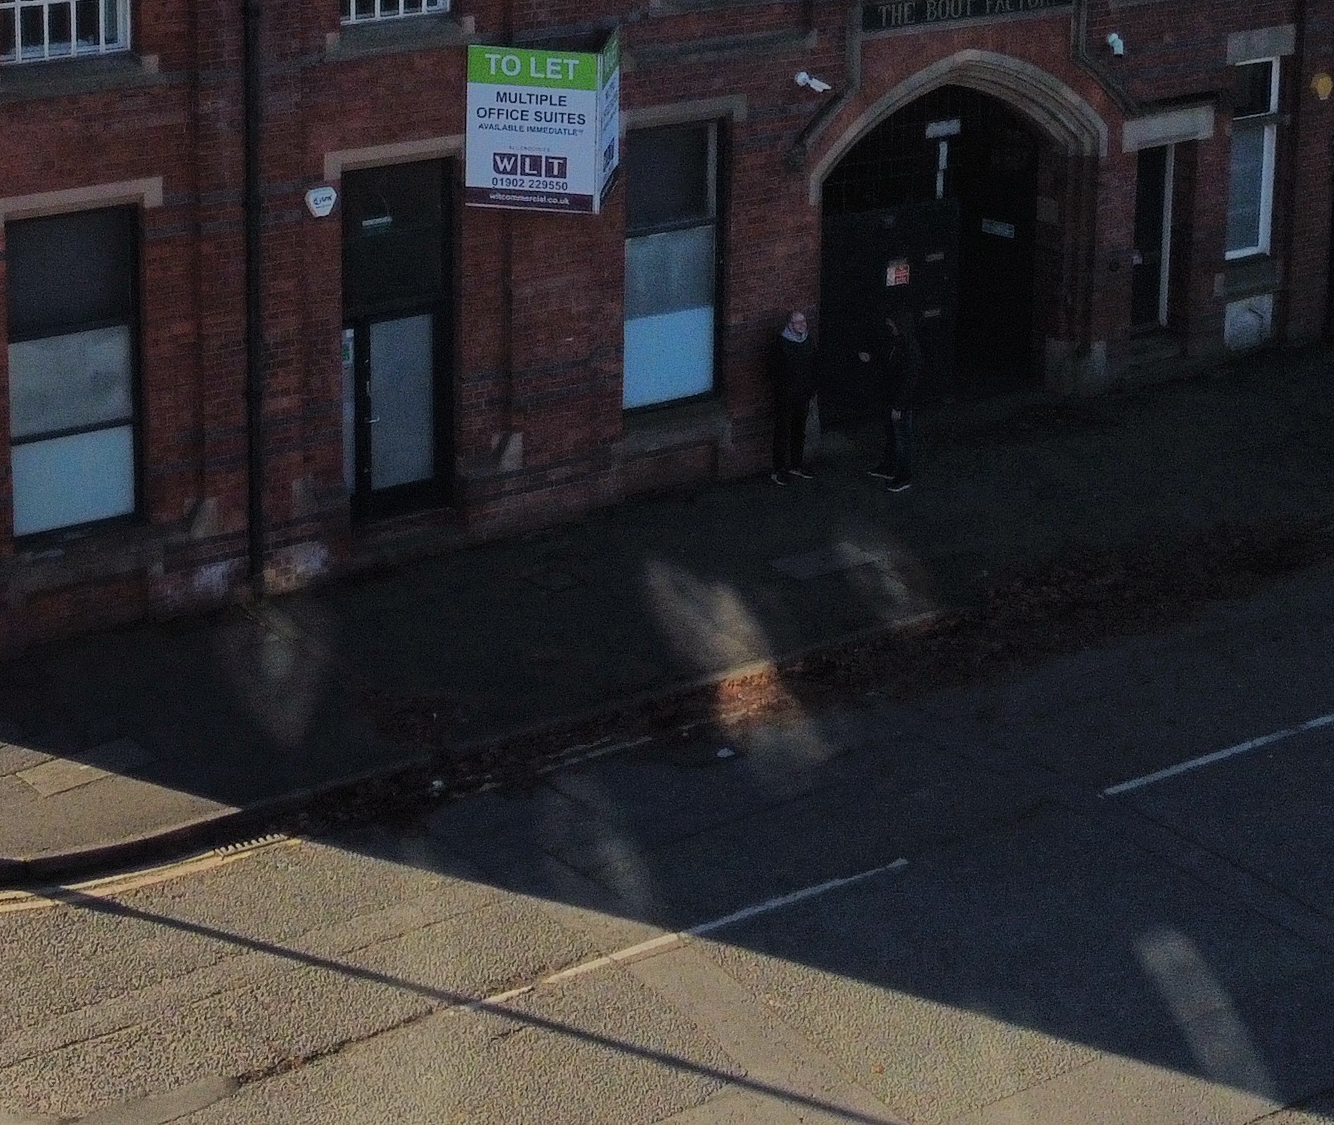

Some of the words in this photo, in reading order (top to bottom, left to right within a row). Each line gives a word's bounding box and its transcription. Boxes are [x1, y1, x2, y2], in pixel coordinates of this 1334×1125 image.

[878, 1, 916, 27] THE
[485, 53, 521, 76] TO
[530, 57, 580, 81] LET
[495, 91, 567, 107] MULTIPLE
[476, 106, 529, 121] OFFICE
[533, 110, 586, 125] SUITES
[477, 122, 525, 133] AVAILABLE
[491, 177, 525, 188] 01902
[528, 179, 568, 191] 229550
